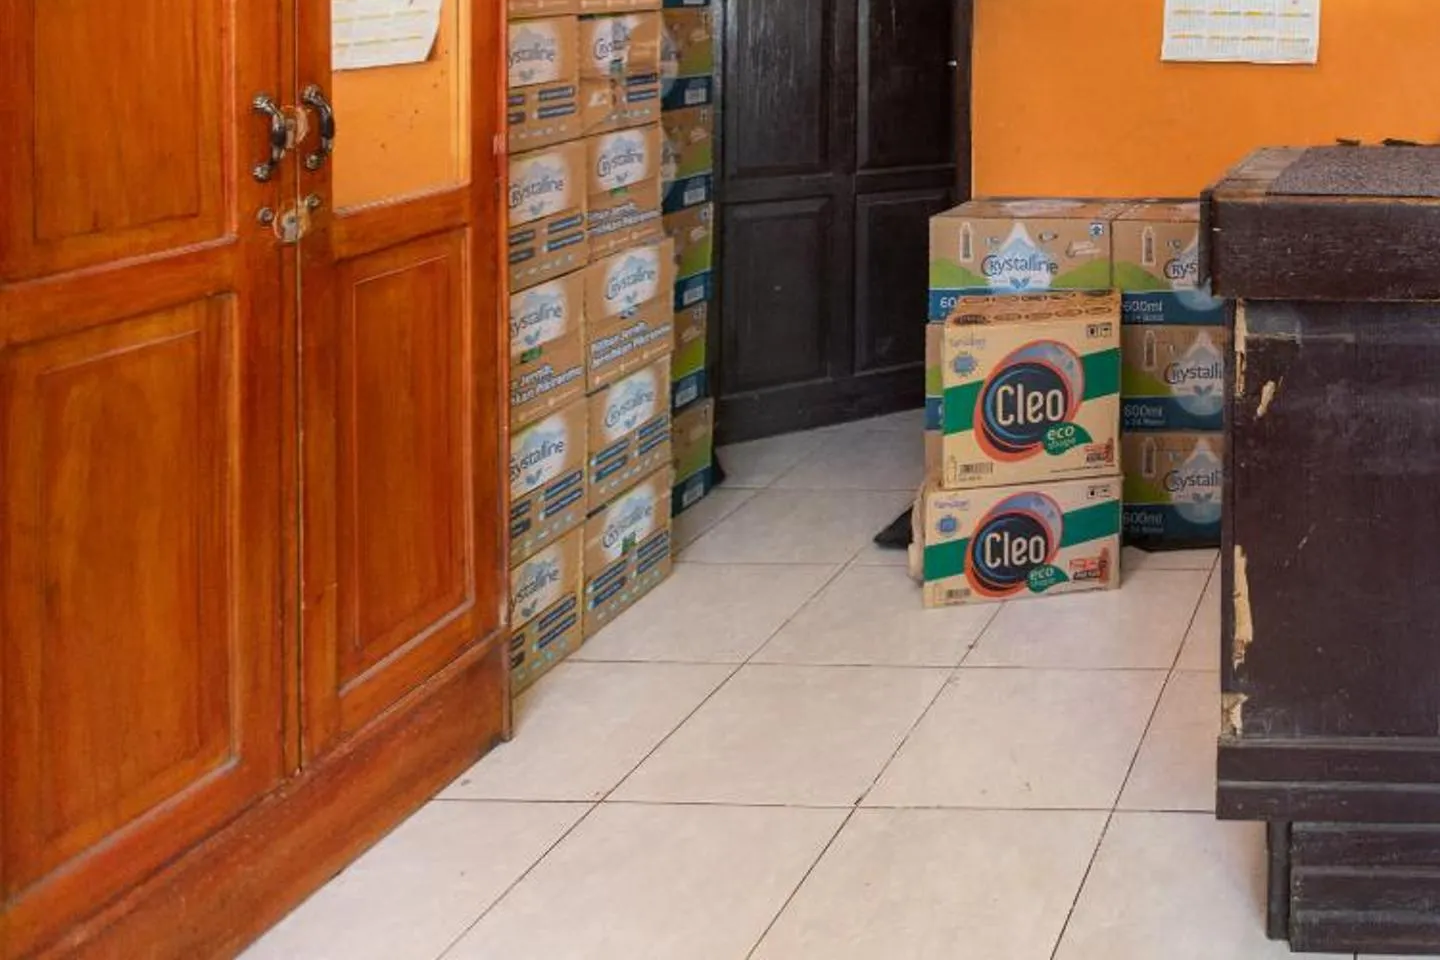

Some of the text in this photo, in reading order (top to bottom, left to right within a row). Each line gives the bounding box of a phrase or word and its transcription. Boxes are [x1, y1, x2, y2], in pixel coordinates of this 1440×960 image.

[981, 253, 1059, 278] Crystalline
[996, 383, 1065, 427] Cleo
[984, 531, 1046, 569] Cleo
